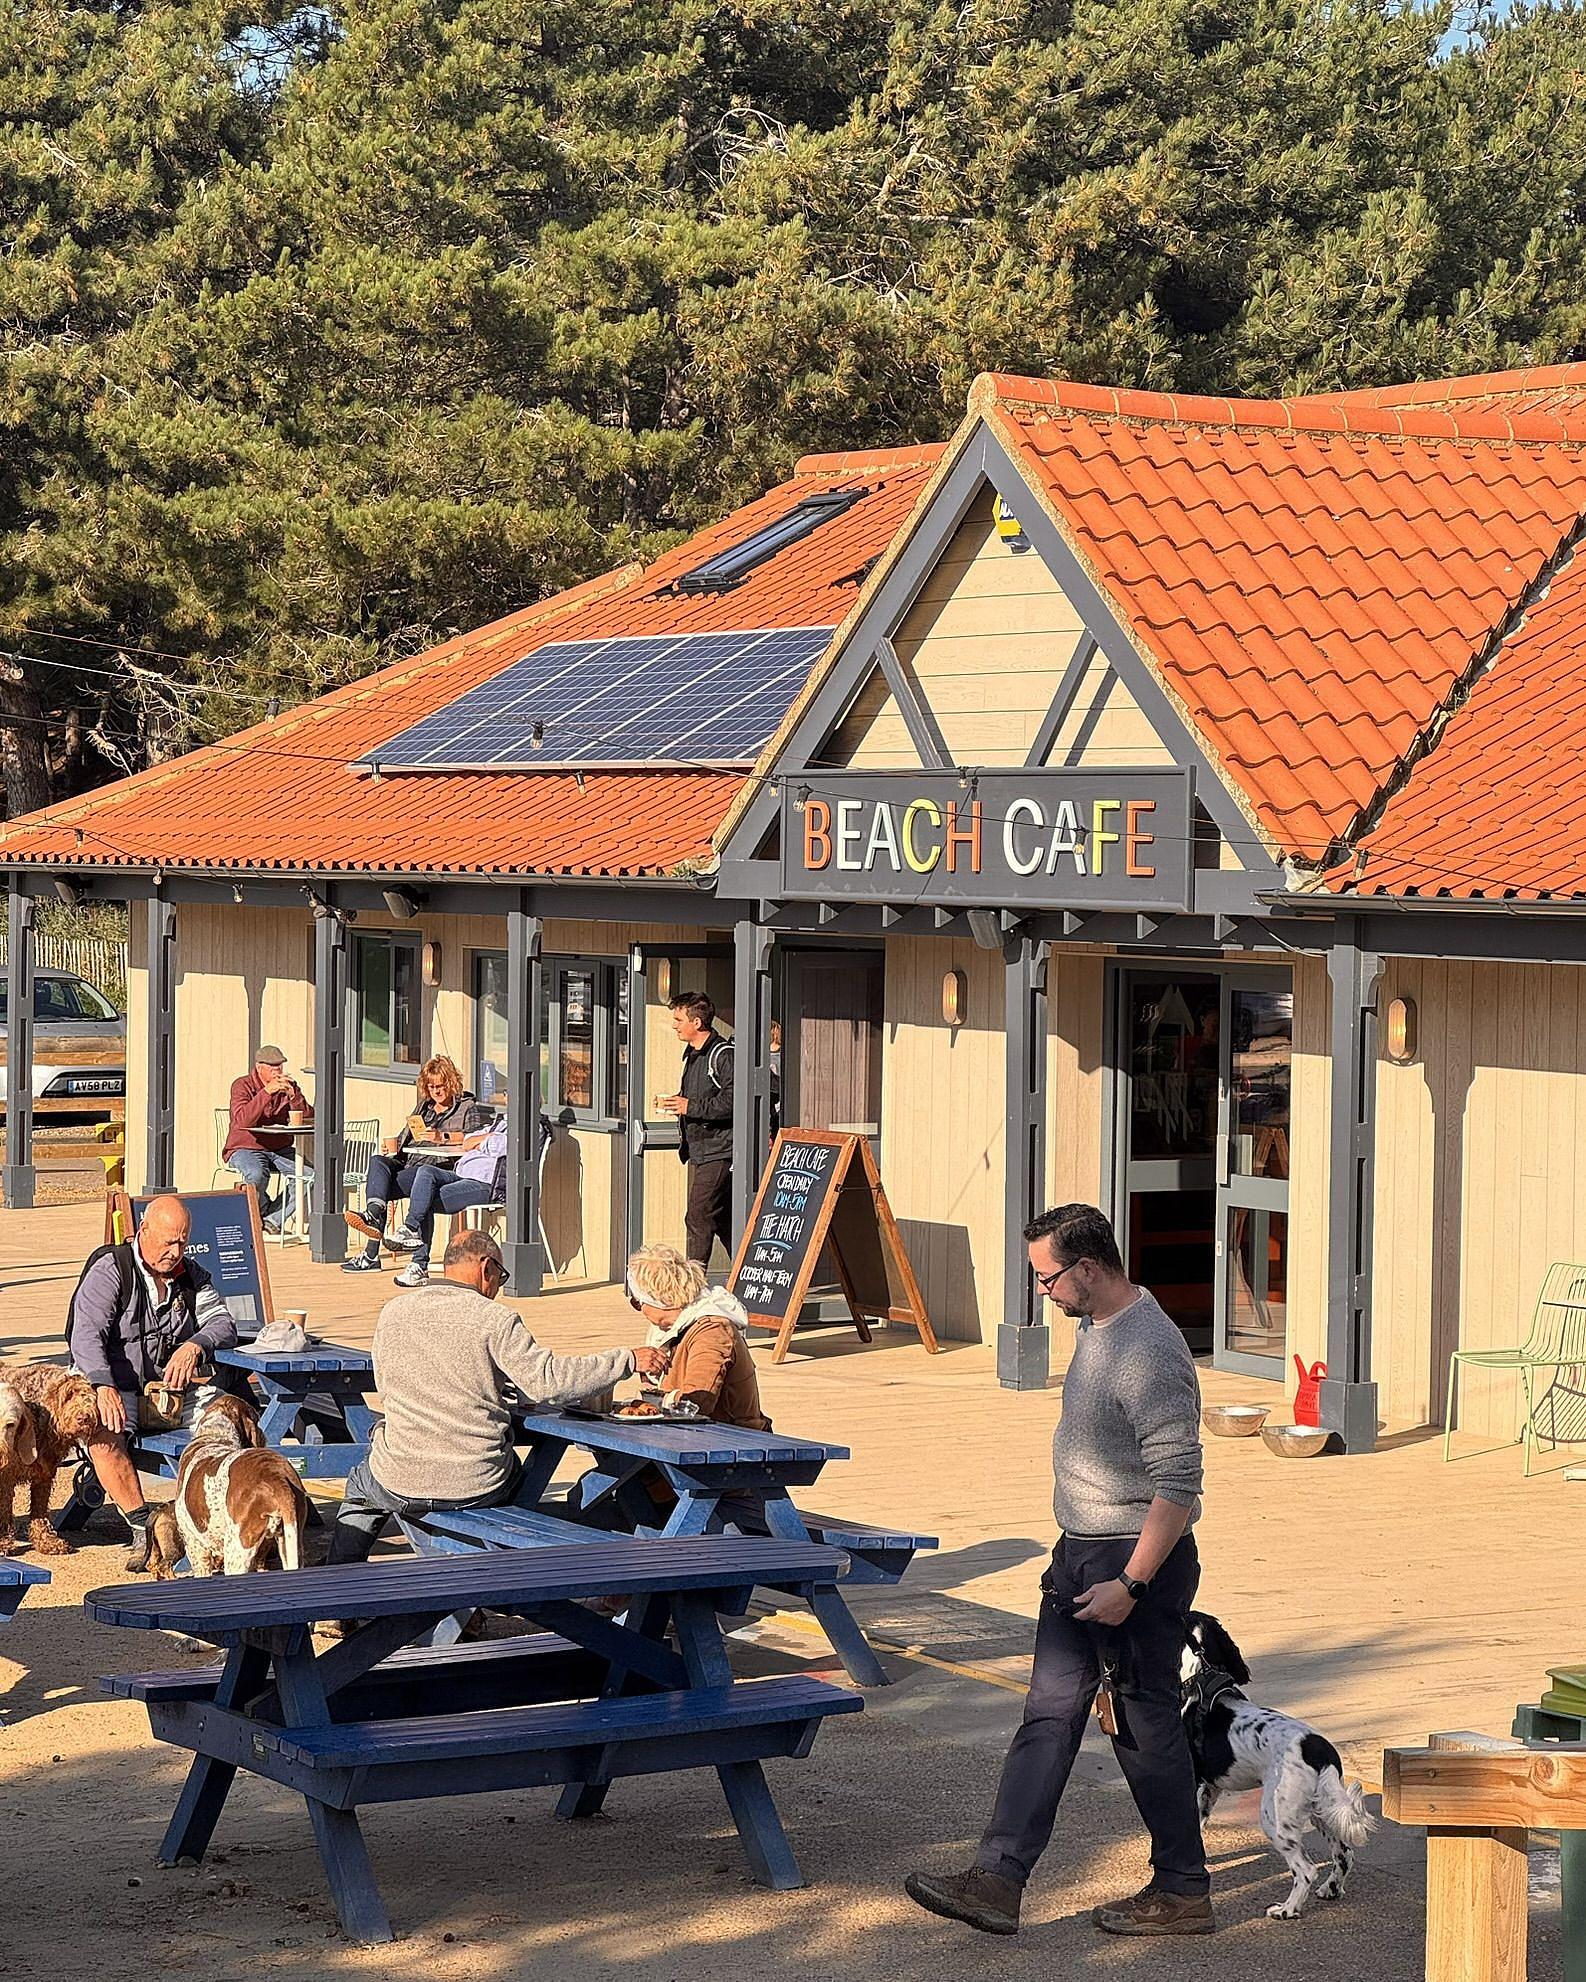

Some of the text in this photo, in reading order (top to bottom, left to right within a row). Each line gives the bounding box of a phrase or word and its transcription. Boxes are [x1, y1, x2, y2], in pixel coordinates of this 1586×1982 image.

[803, 797, 1156, 876] BEACH CAFE
[74, 1080, 120, 1091] AV58 PLZ
[780, 1145, 830, 1172] BEACH CAFE
[760, 1213, 805, 1242] THE HATCH
